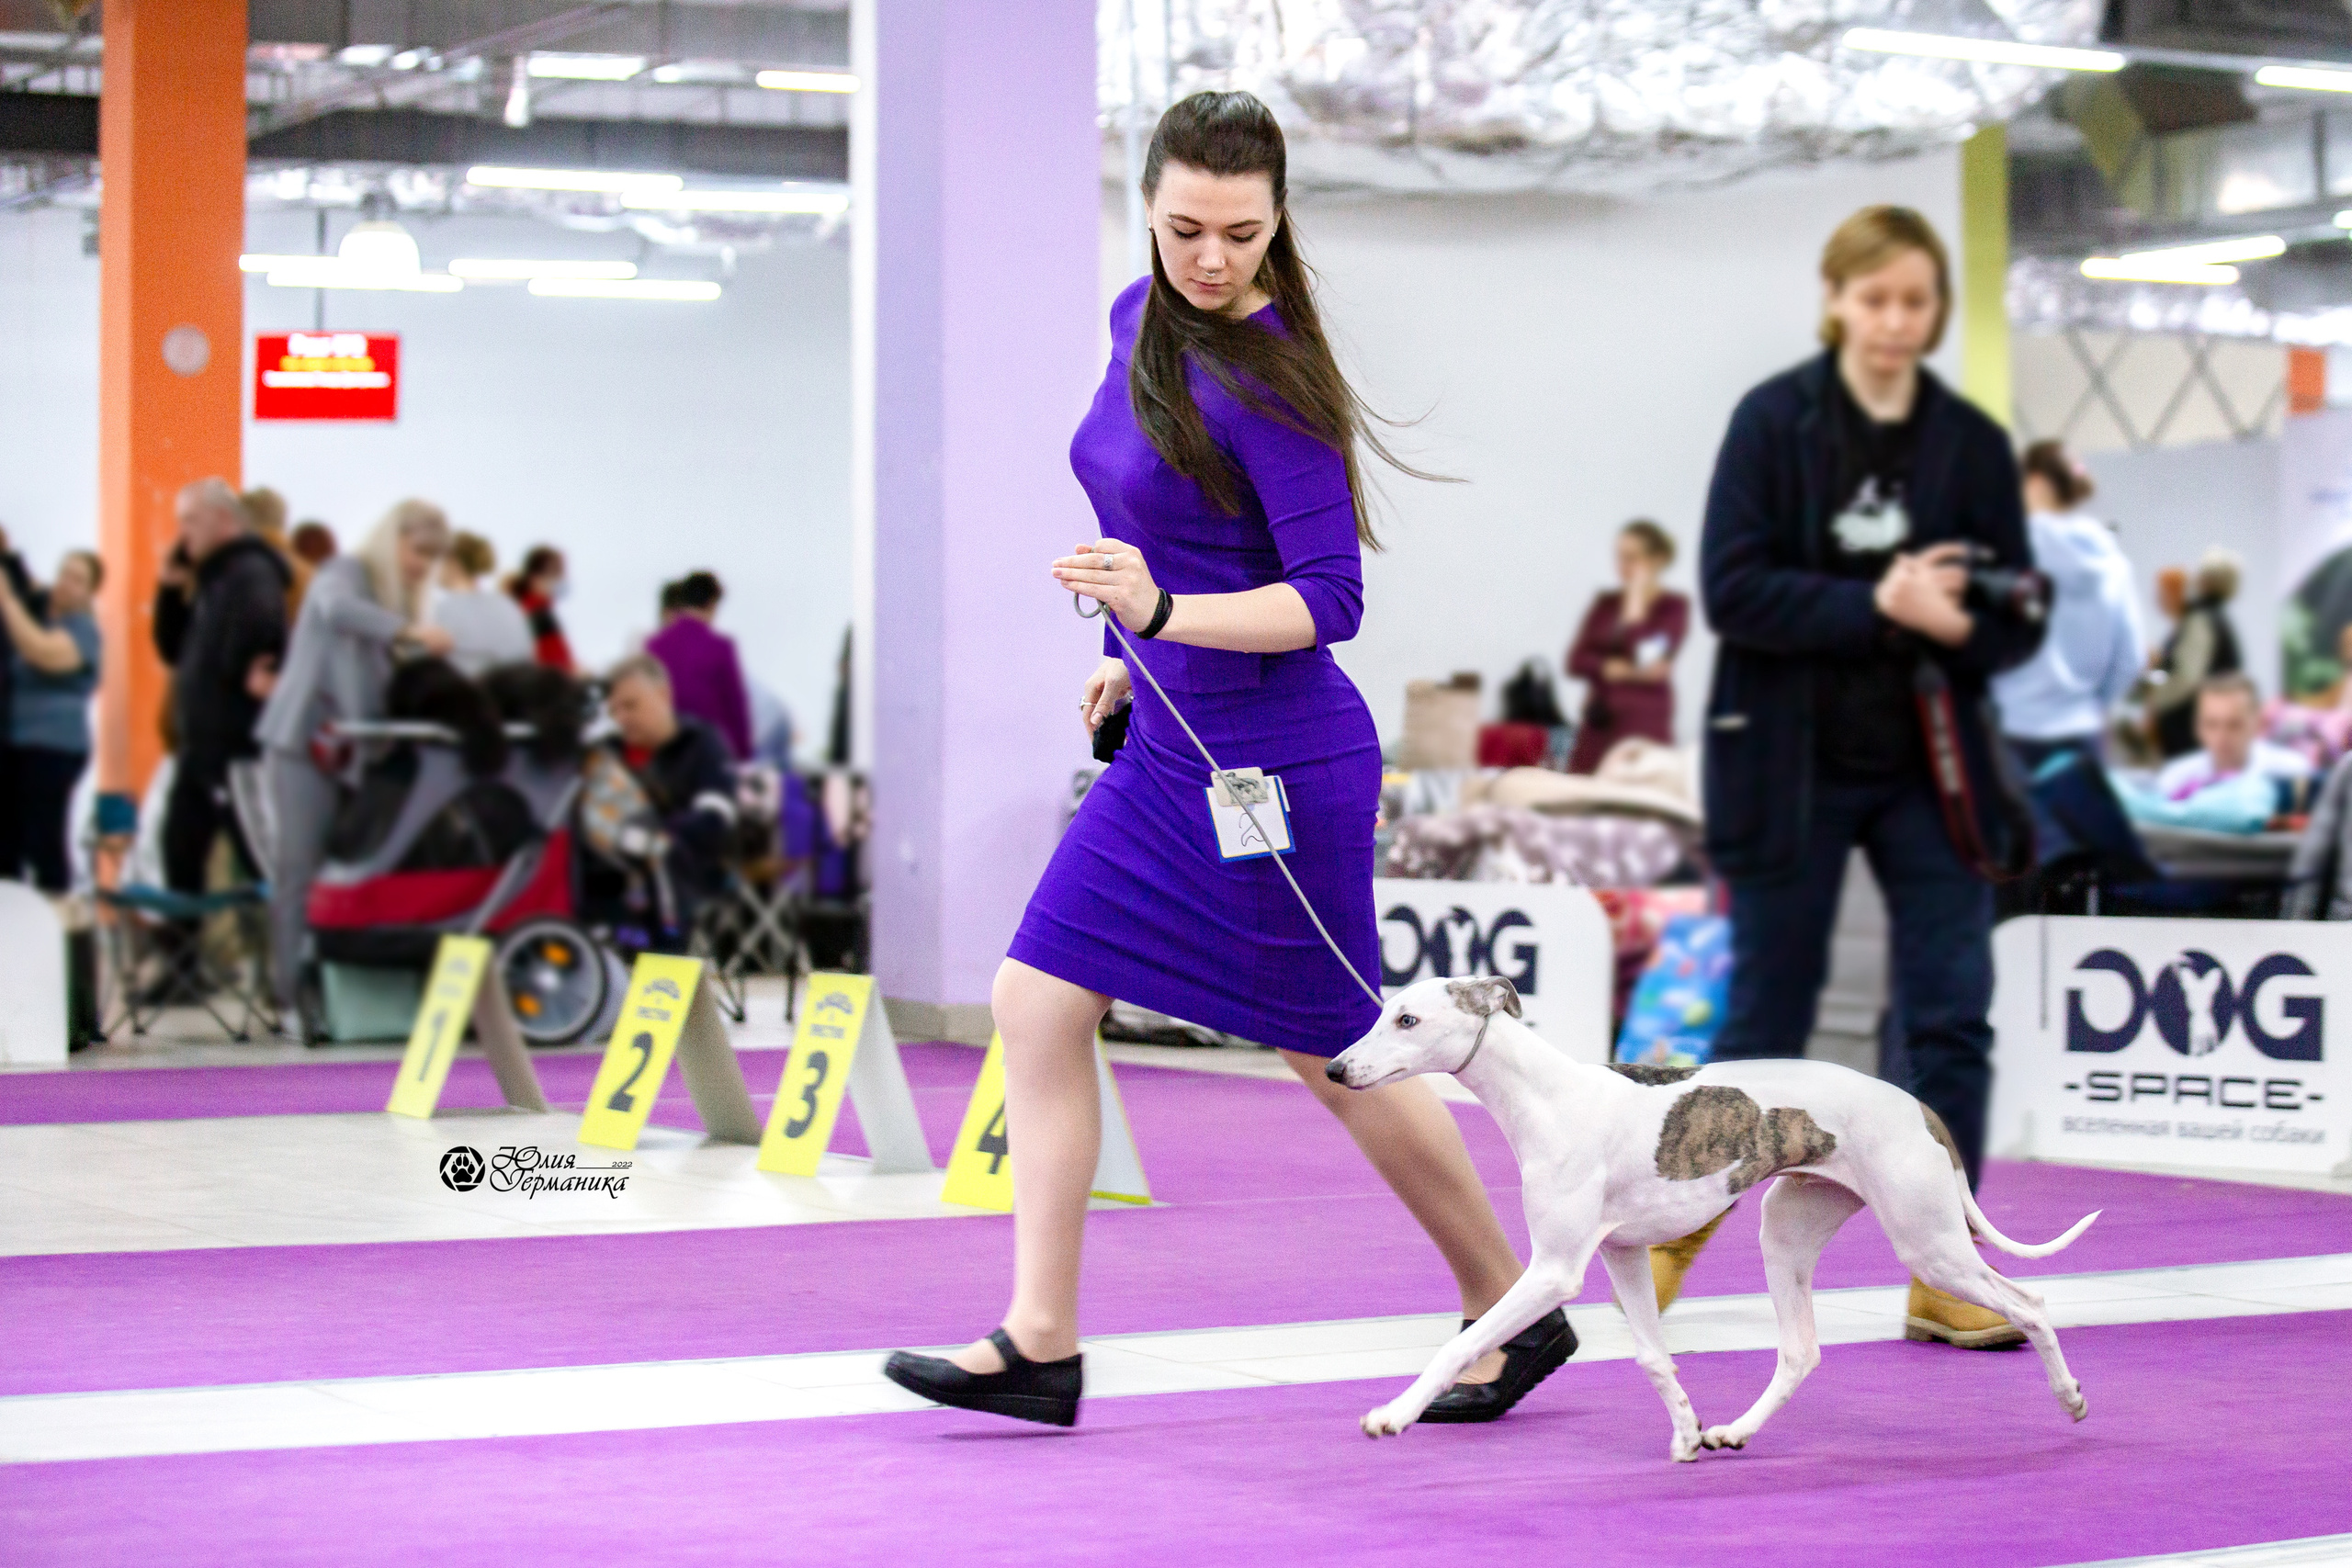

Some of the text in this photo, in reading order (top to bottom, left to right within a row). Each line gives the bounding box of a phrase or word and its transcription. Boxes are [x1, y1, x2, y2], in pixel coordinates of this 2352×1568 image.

[2065, 946, 2326, 1062] DOG
[418, 1008, 448, 1082] 1
[606, 1031, 654, 1112] 2
[784, 1050, 830, 1139] 3
[975, 1100, 1009, 1175] 4
